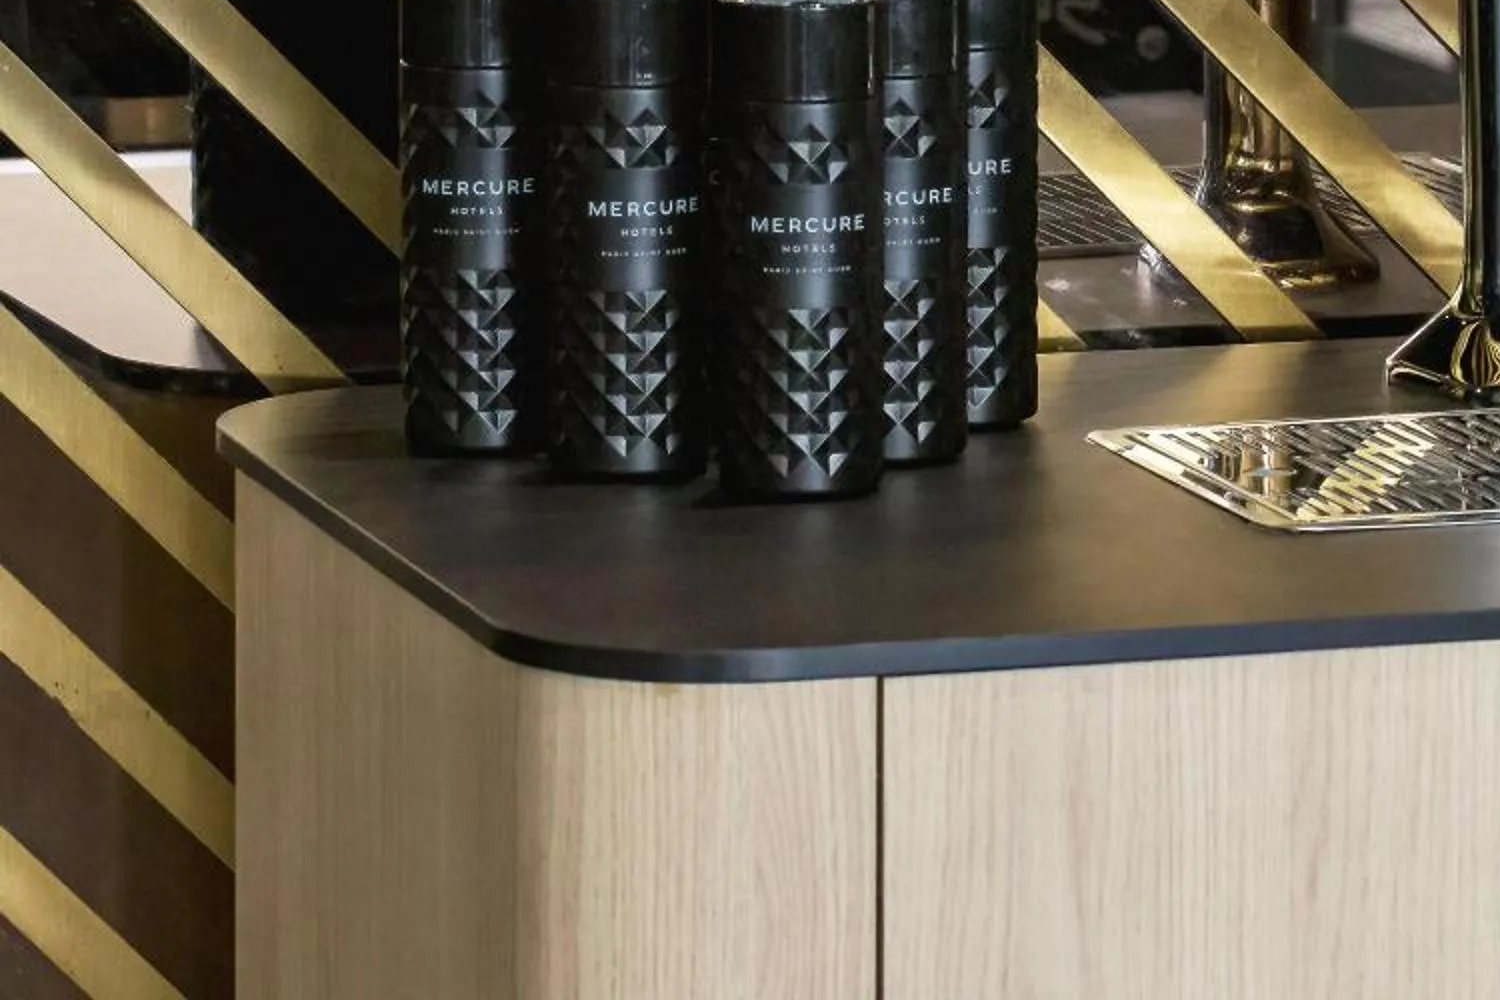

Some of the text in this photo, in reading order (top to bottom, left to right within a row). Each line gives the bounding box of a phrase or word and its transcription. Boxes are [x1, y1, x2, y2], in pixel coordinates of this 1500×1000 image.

[422, 177, 536, 196] MERCURE
[450, 206, 504, 216] HOTELS
[588, 196, 700, 217] MERCURE
[751, 213, 865, 233] MERCURE
[621, 225, 673, 237] HOTELS
[781, 244, 837, 254] HOTELS
